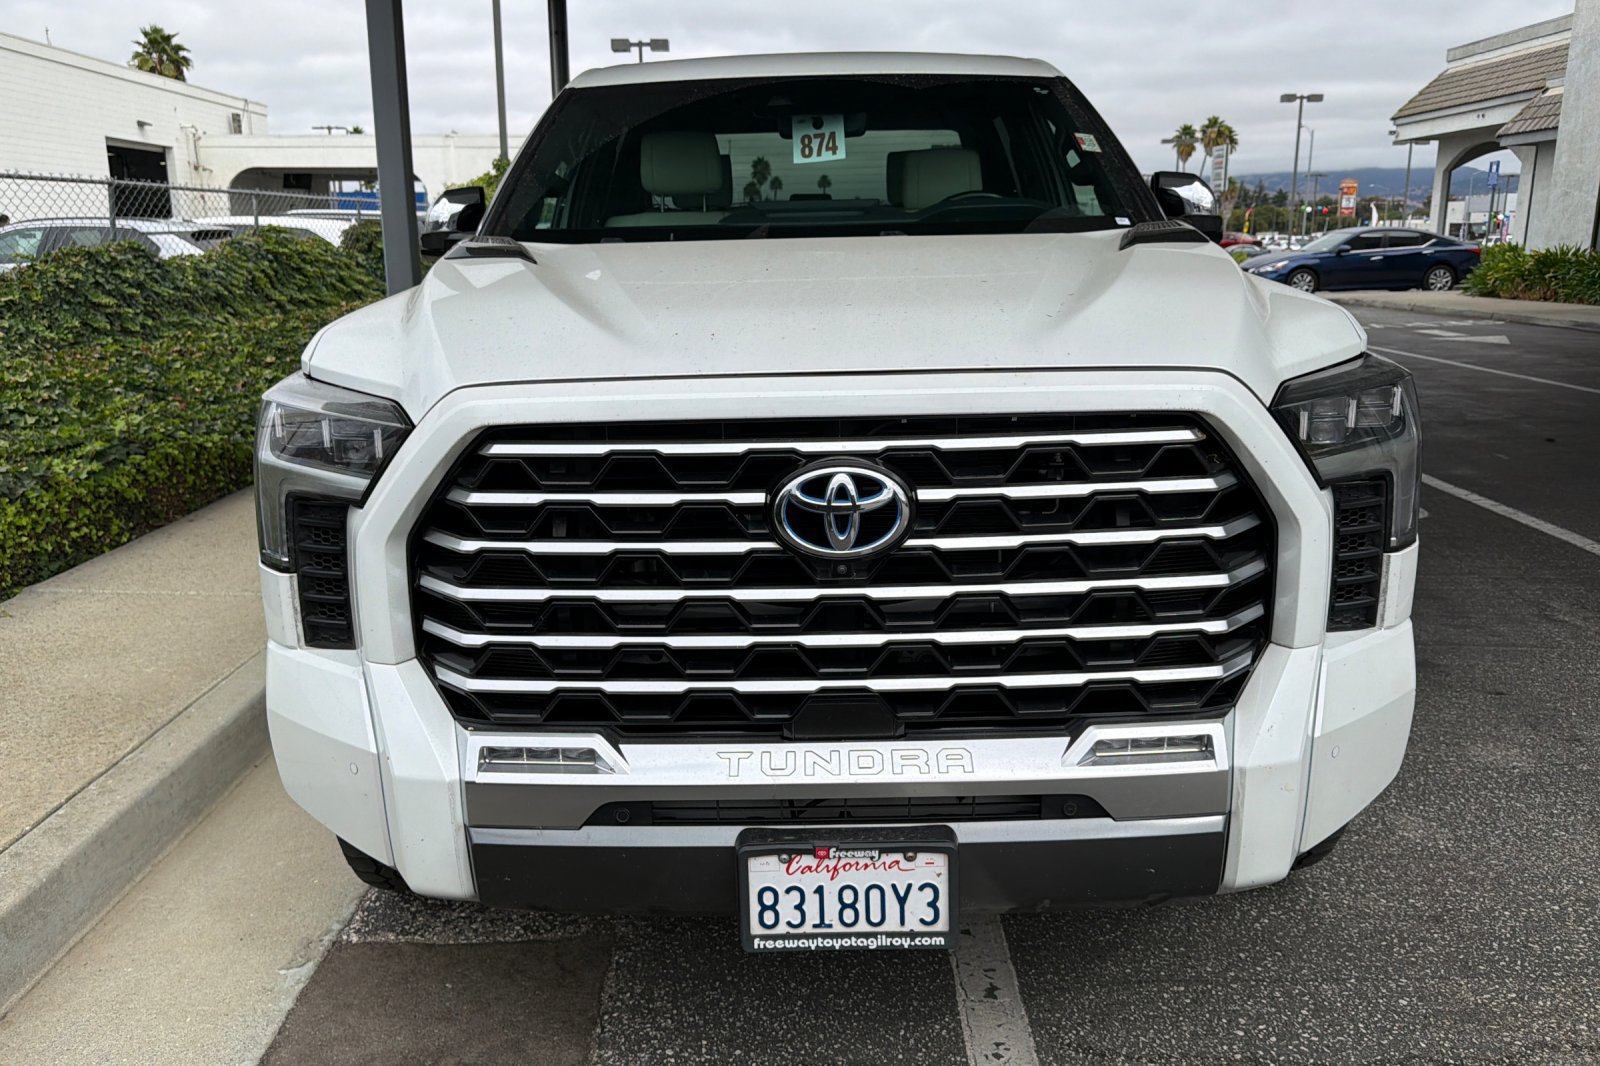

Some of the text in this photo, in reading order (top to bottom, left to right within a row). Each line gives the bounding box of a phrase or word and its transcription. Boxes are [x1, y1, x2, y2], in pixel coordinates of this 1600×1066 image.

[800, 131, 838, 159] 874
[716, 748, 974, 777] TUNDRA
[785, 854, 915, 880] California
[757, 882, 940, 929] 83180Y3
[753, 935, 945, 950] freewaytoyotagilroy.com
